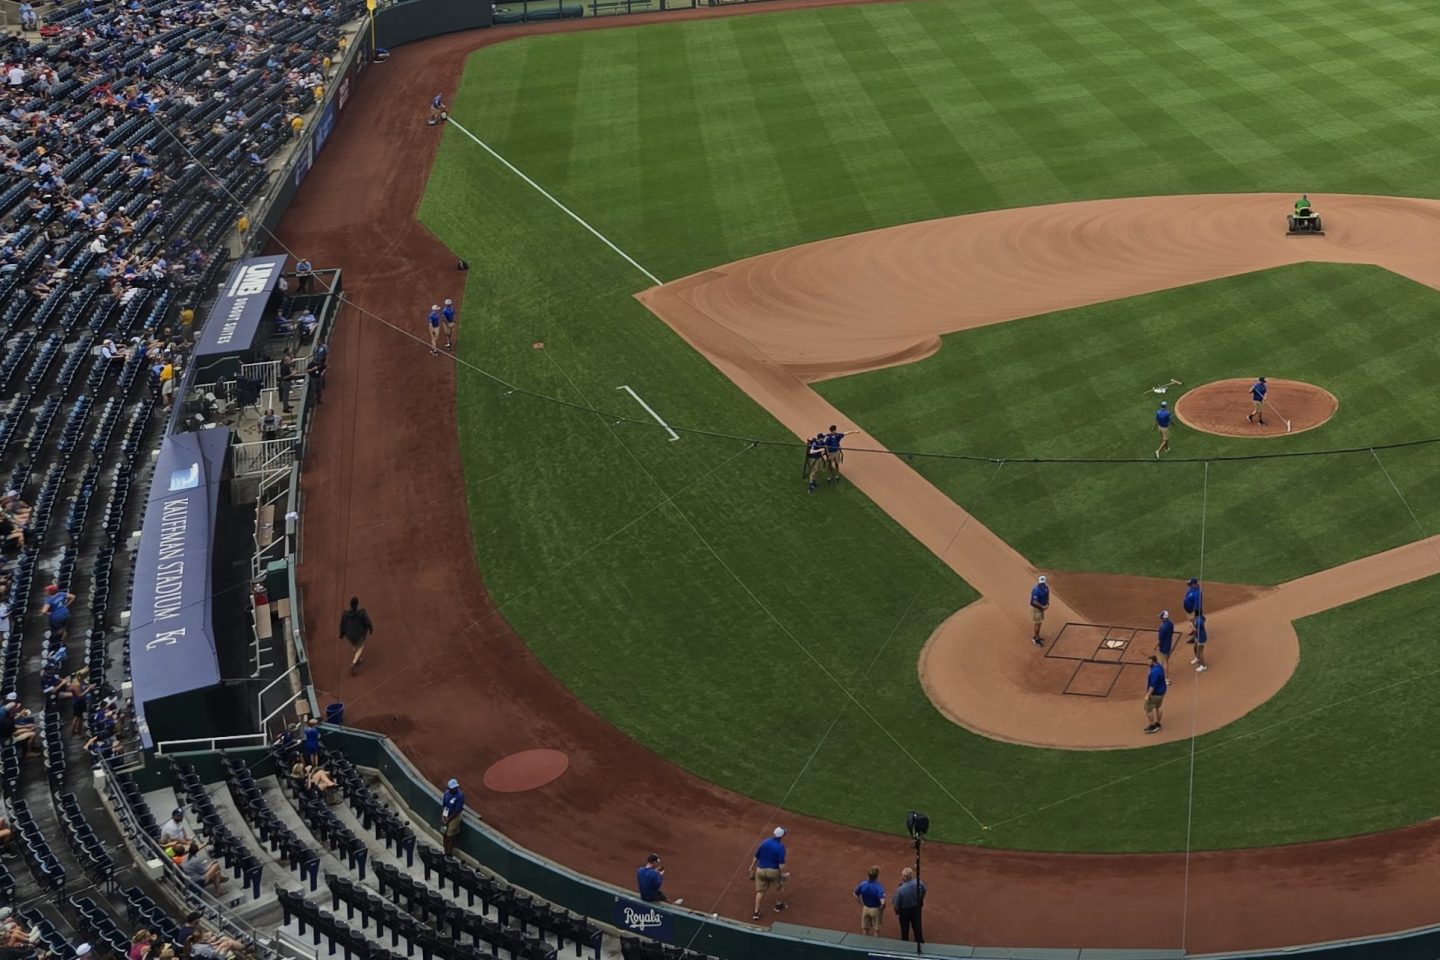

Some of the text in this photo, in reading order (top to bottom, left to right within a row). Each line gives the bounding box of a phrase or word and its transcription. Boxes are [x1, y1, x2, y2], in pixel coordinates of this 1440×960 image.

[242, 262, 275, 297] UMB
[216, 322, 237, 345] SUITES
[158, 497, 189, 560] KAUFFMAN
[153, 562, 184, 623] STADIUM
[623, 907, 663, 931] Royals
